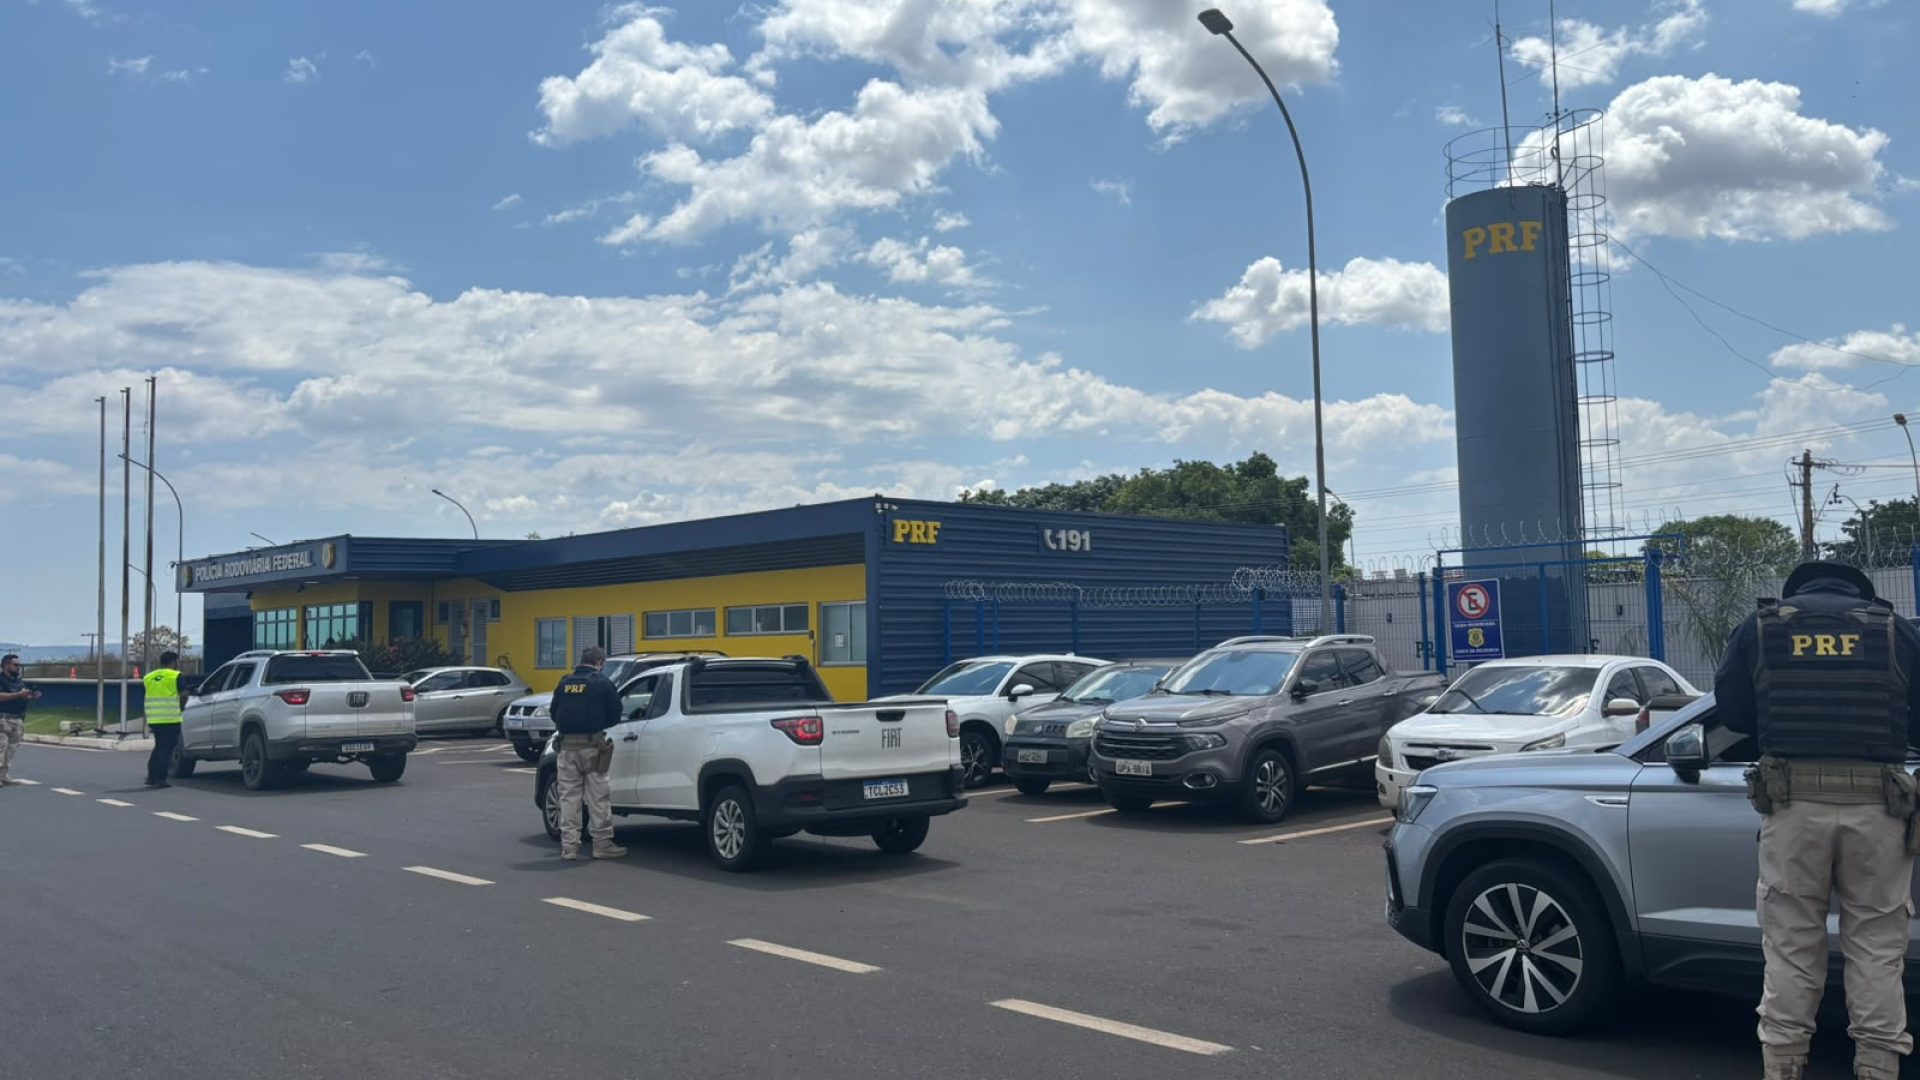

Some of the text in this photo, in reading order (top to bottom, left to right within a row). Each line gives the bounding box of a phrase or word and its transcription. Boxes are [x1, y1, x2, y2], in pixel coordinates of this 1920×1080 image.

[1462, 221, 1544, 260] PRF
[892, 519, 941, 544] PRF
[1056, 529, 1091, 551] 191
[272, 551, 313, 571] FEDERAL
[1791, 633, 1861, 656] PRF
[564, 683, 587, 694] PRF
[881, 728, 902, 749] FIAT
